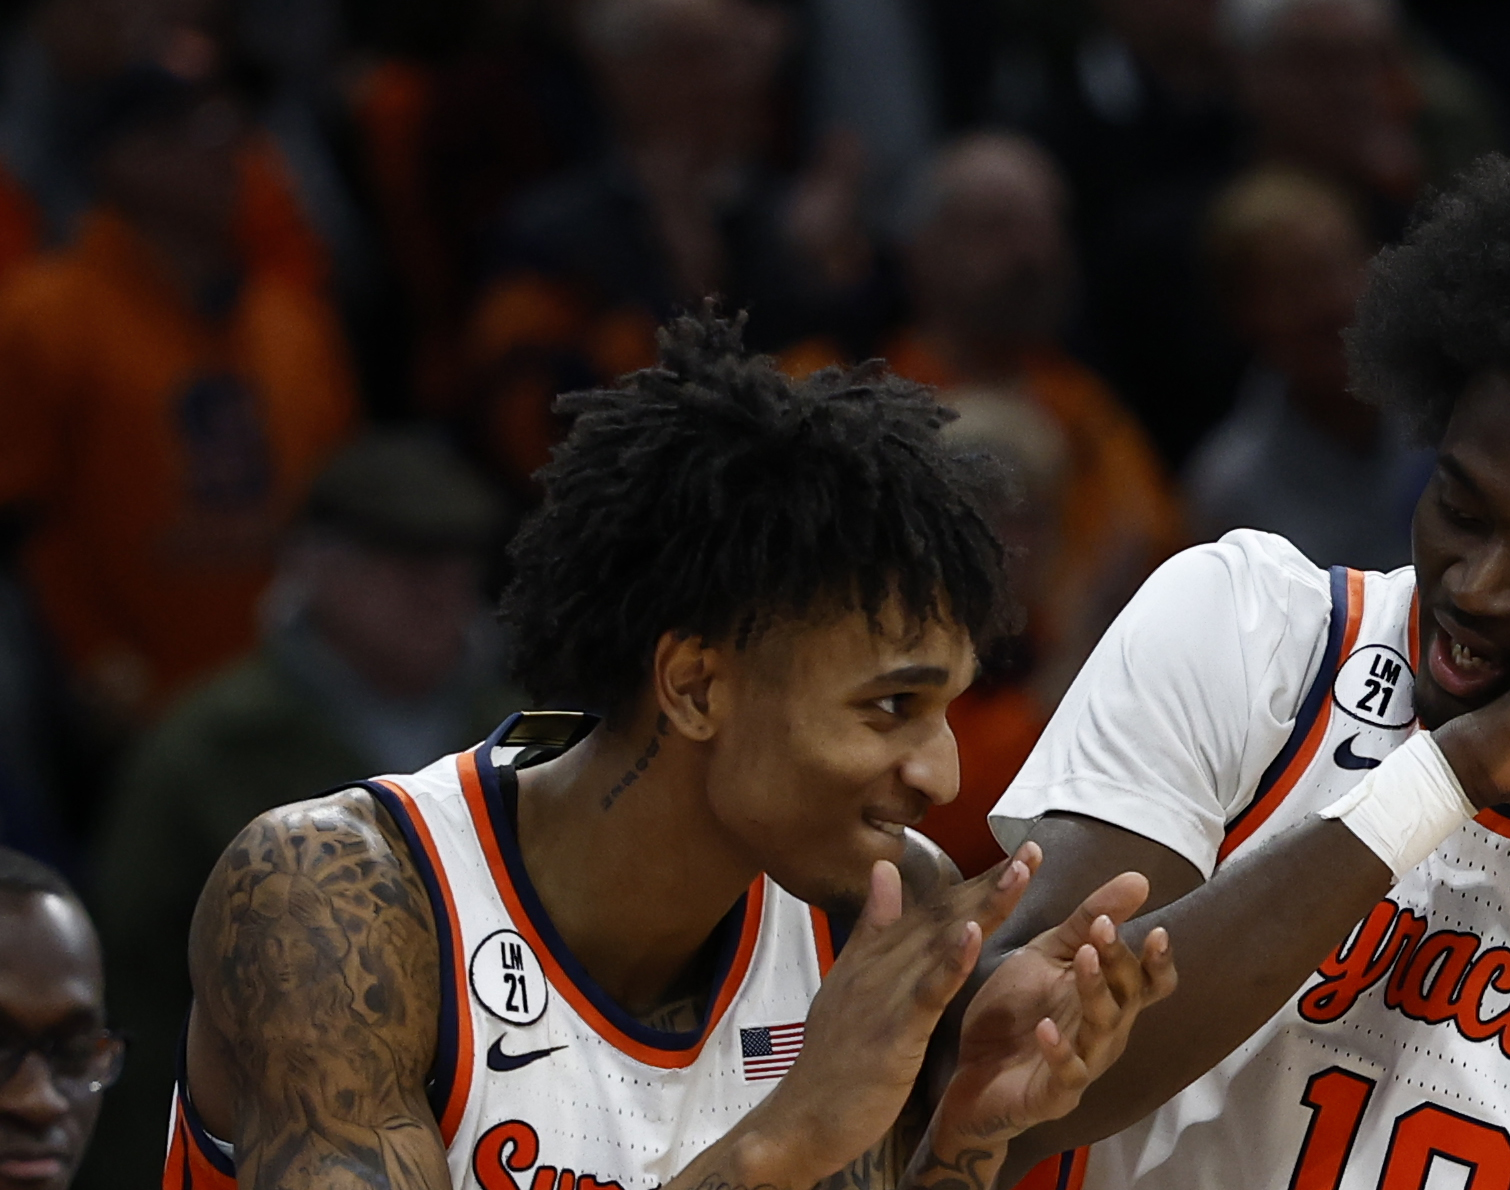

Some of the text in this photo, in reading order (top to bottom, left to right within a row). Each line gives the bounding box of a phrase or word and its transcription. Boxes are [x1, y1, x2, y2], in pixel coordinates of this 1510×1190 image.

[1369, 653, 1402, 687] LM
[1355, 678, 1394, 718] 21
[500, 941, 524, 972] LM
[503, 972, 530, 1014] 21
